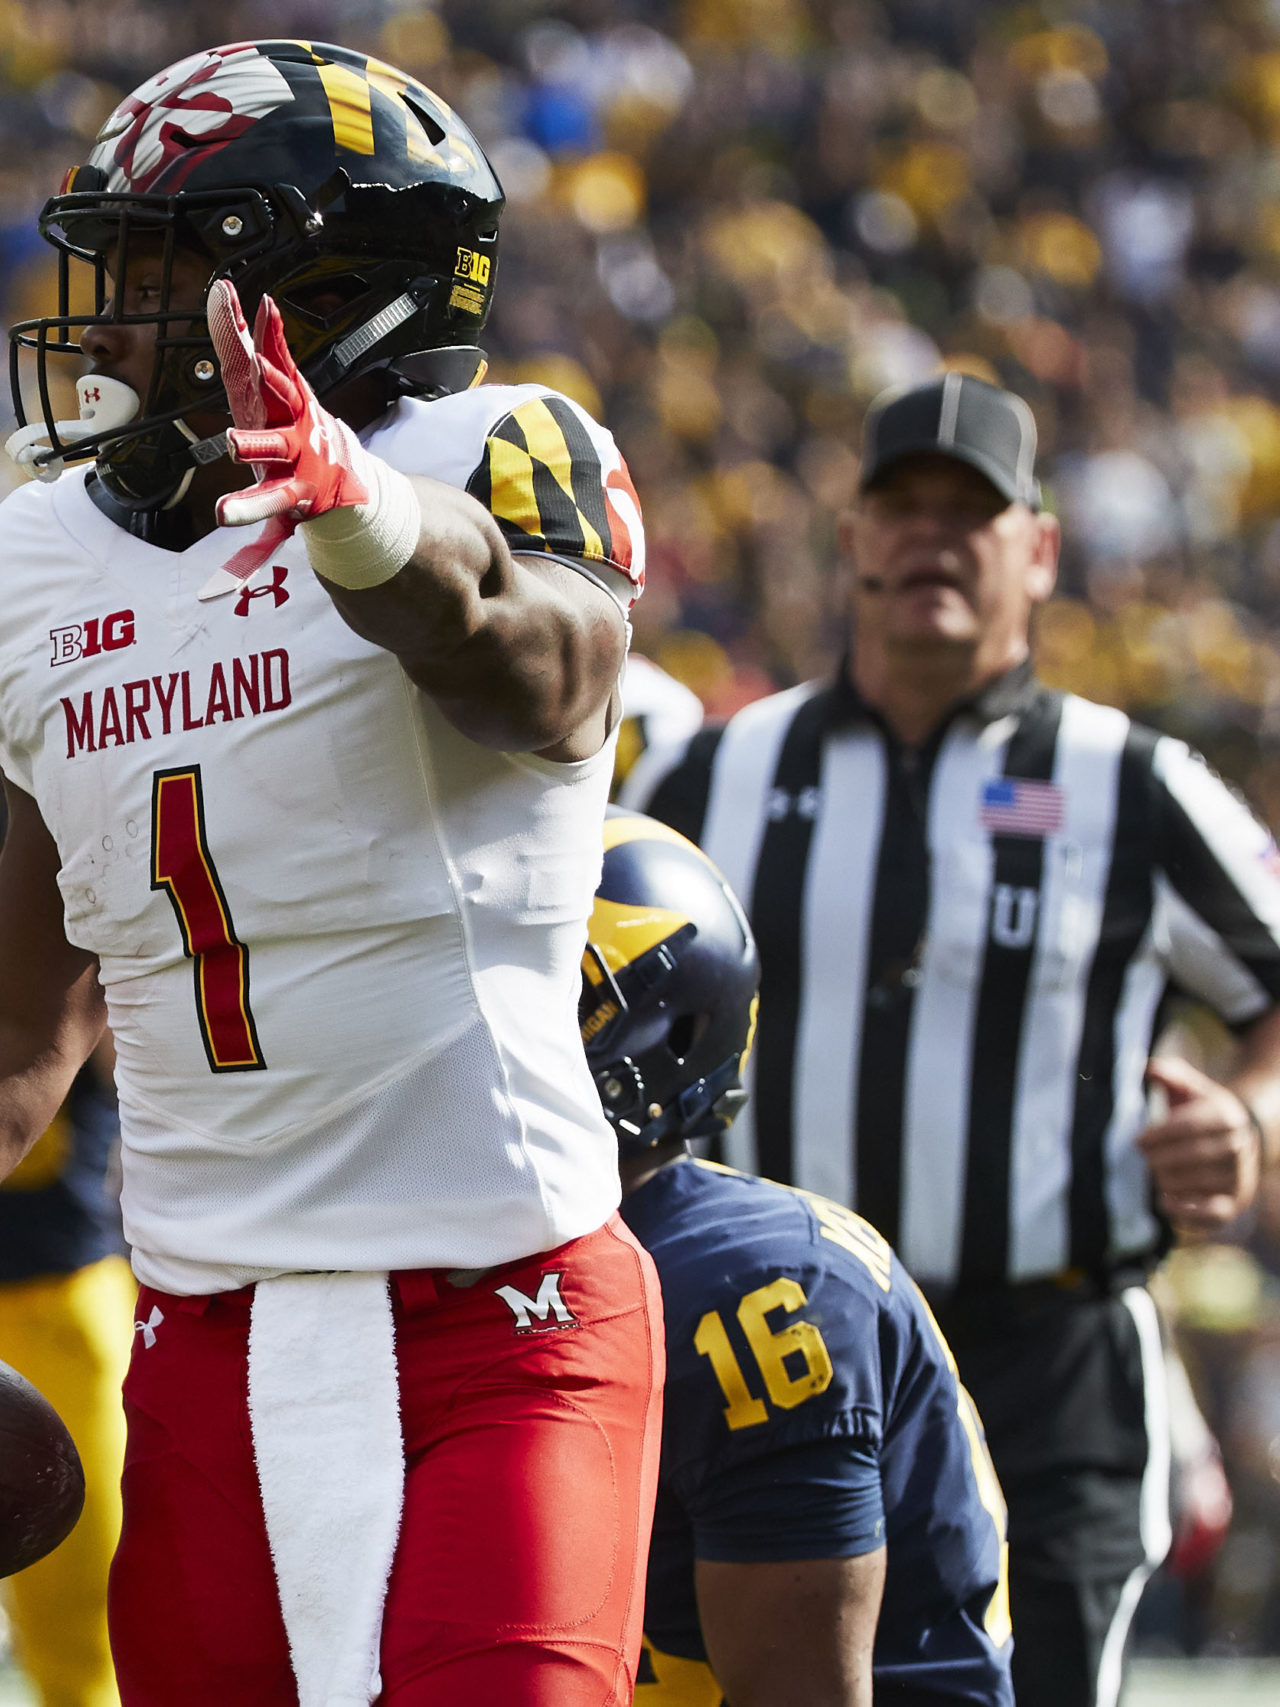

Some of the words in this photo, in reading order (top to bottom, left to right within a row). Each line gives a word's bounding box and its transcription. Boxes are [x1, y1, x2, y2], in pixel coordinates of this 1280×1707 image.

[60, 647, 292, 759] MARYLAND
[150, 763, 268, 1074] 1
[993, 882, 1036, 948] U
[492, 1271, 577, 1329] M
[692, 1276, 834, 1432] 16
